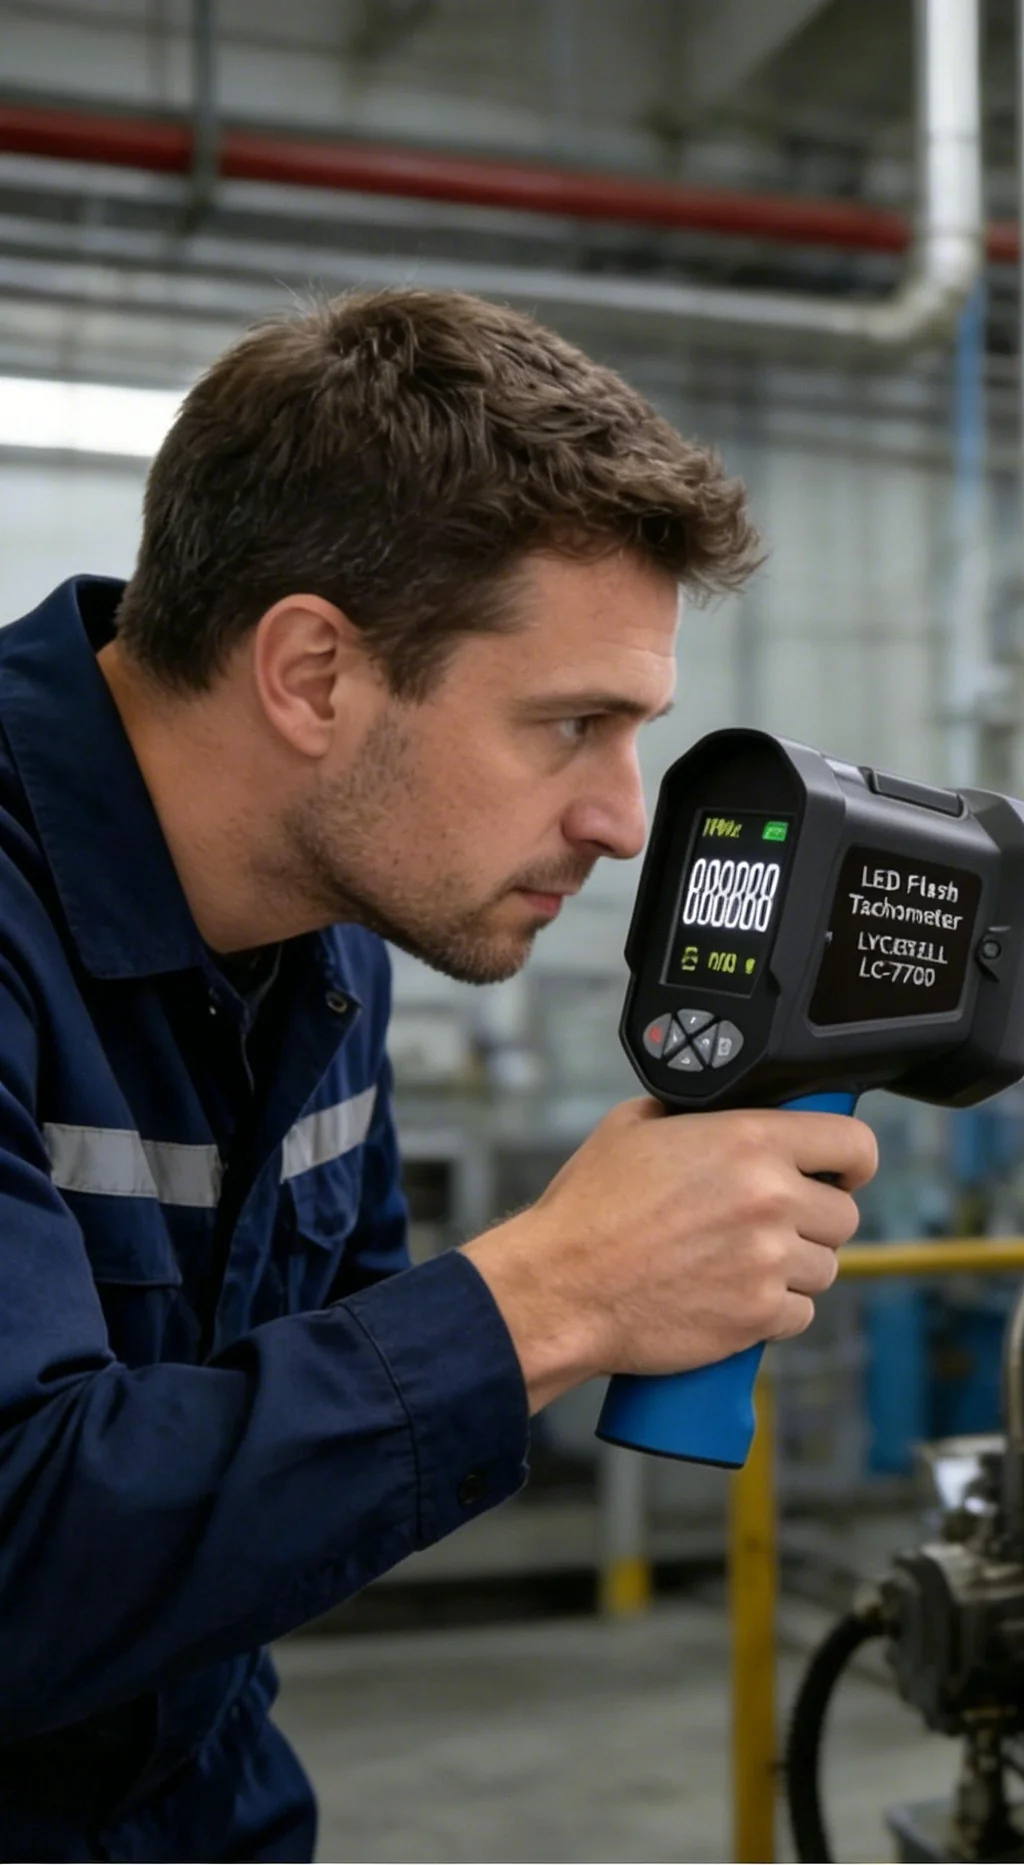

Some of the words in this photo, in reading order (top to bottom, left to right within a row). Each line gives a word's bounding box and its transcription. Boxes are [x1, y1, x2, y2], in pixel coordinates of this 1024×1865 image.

[861, 865, 901, 891] LED
[907, 875, 959, 903] Flash
[849, 892, 964, 931] Tachometer
[859, 956, 936, 987] LC-7700
